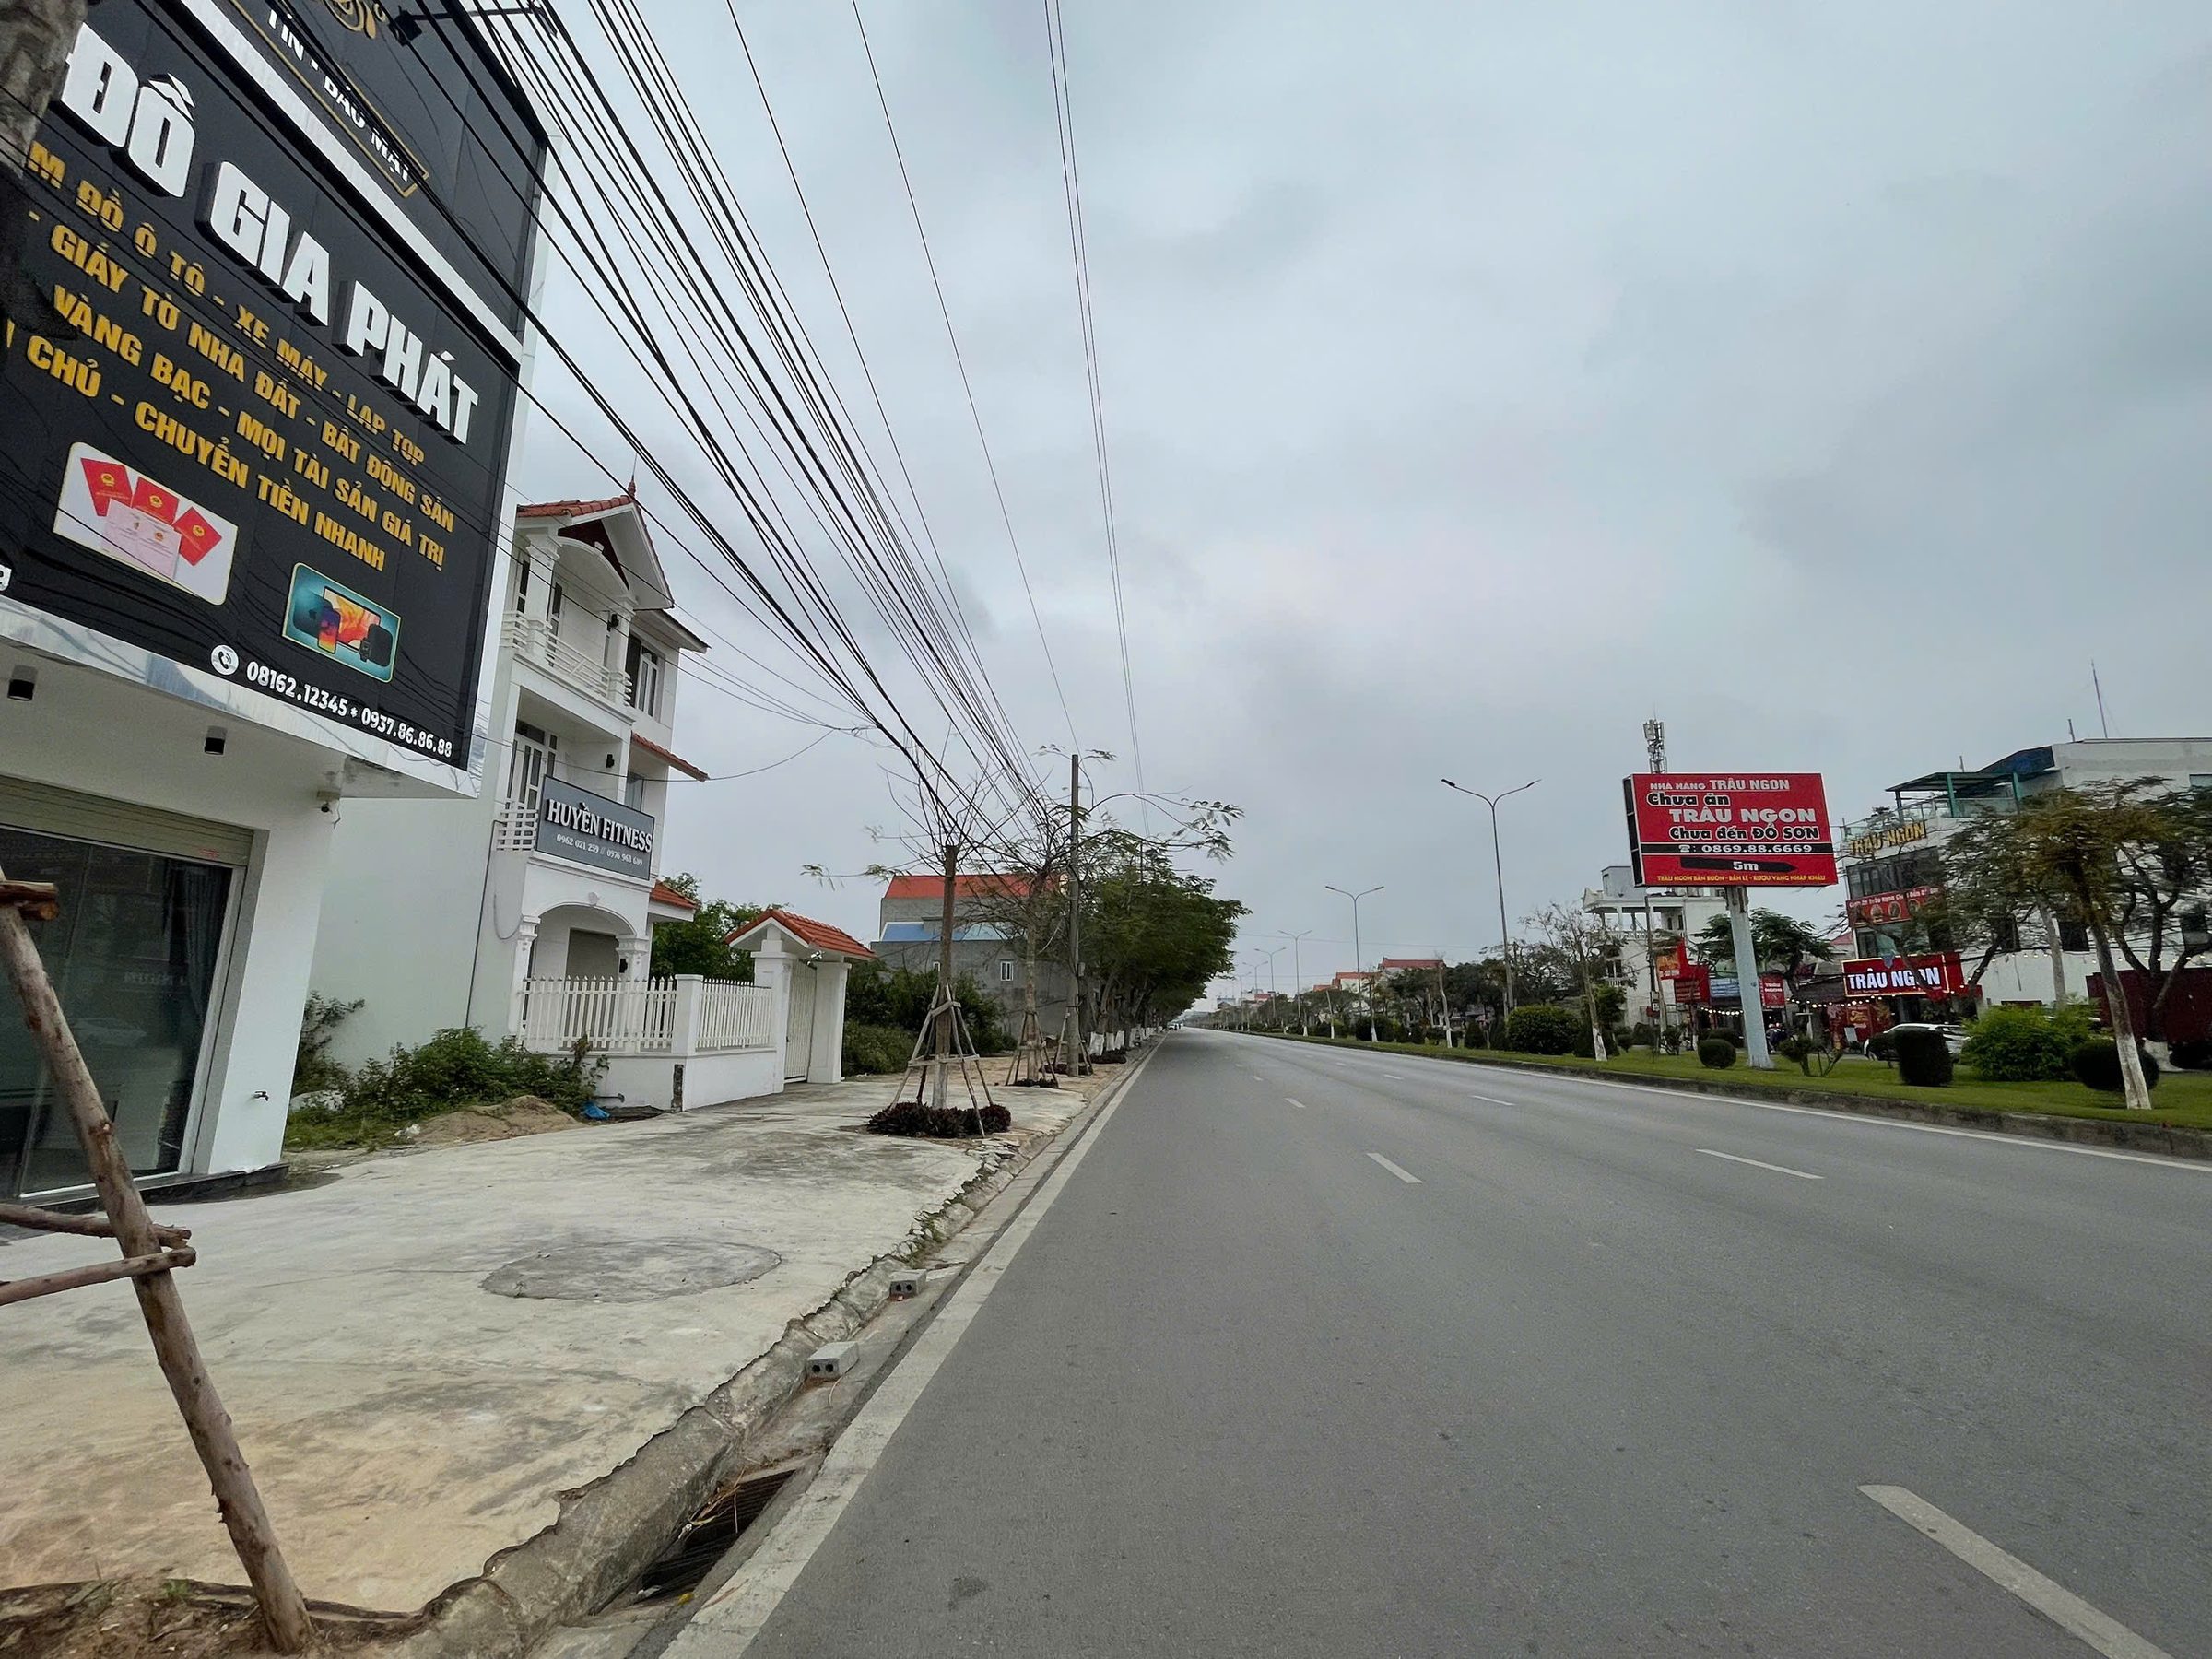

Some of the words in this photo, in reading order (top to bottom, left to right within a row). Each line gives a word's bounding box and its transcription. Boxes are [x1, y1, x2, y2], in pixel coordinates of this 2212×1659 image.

[209, 160, 329, 326] GIA
[347, 280, 478, 445] PHÁT
[76, 179, 124, 232] ĐỒ
[134, 222, 157, 258] Ô
[169, 250, 205, 297] TÔ
[233, 304, 270, 349] XE
[276, 338, 328, 391] MÁY
[347, 394, 386, 435] LAP
[392, 428, 425, 466] TOP
[53, 284, 143, 367] VÀNG
[150, 352, 211, 409] BẠC
[236, 410, 286, 461] MỌI
[293, 447, 329, 490] TÀI
[334, 478, 377, 523] SẢN
[381, 510, 412, 547] GIÁ
[418, 533, 445, 571] TRỊ
[254, 371, 300, 419] ĐẤT
[366, 453, 415, 505] ĐỘNG
[27, 335, 101, 397] CHỦ
[135, 401, 249, 488] CHUYỂN
[257, 474, 310, 525] TIỀN
[314, 512, 386, 571] NHANH
[247, 661, 348, 717] 08162.12345
[361, 707, 453, 759] 0937.86.86.88
[1710, 778, 1746, 790] TRÂU
[1749, 779, 1790, 790] NGON
[1647, 792, 1698, 806] Chưa
[1703, 792, 1730, 806] ăn
[547, 799, 599, 836] HUYỀN
[602, 818, 653, 853] FITNESS
[1669, 806, 1731, 822] TRÂU
[1740, 808, 1816, 822] NGON
[1669, 826, 1712, 840] Chưa
[1716, 825, 1748, 840] đến
[1887, 821, 1926, 847] NGON
[1701, 844, 1812, 853] 0869.88.6669
[1734, 861, 1759, 871] 5m
[1848, 968, 1888, 990] TRÂU
